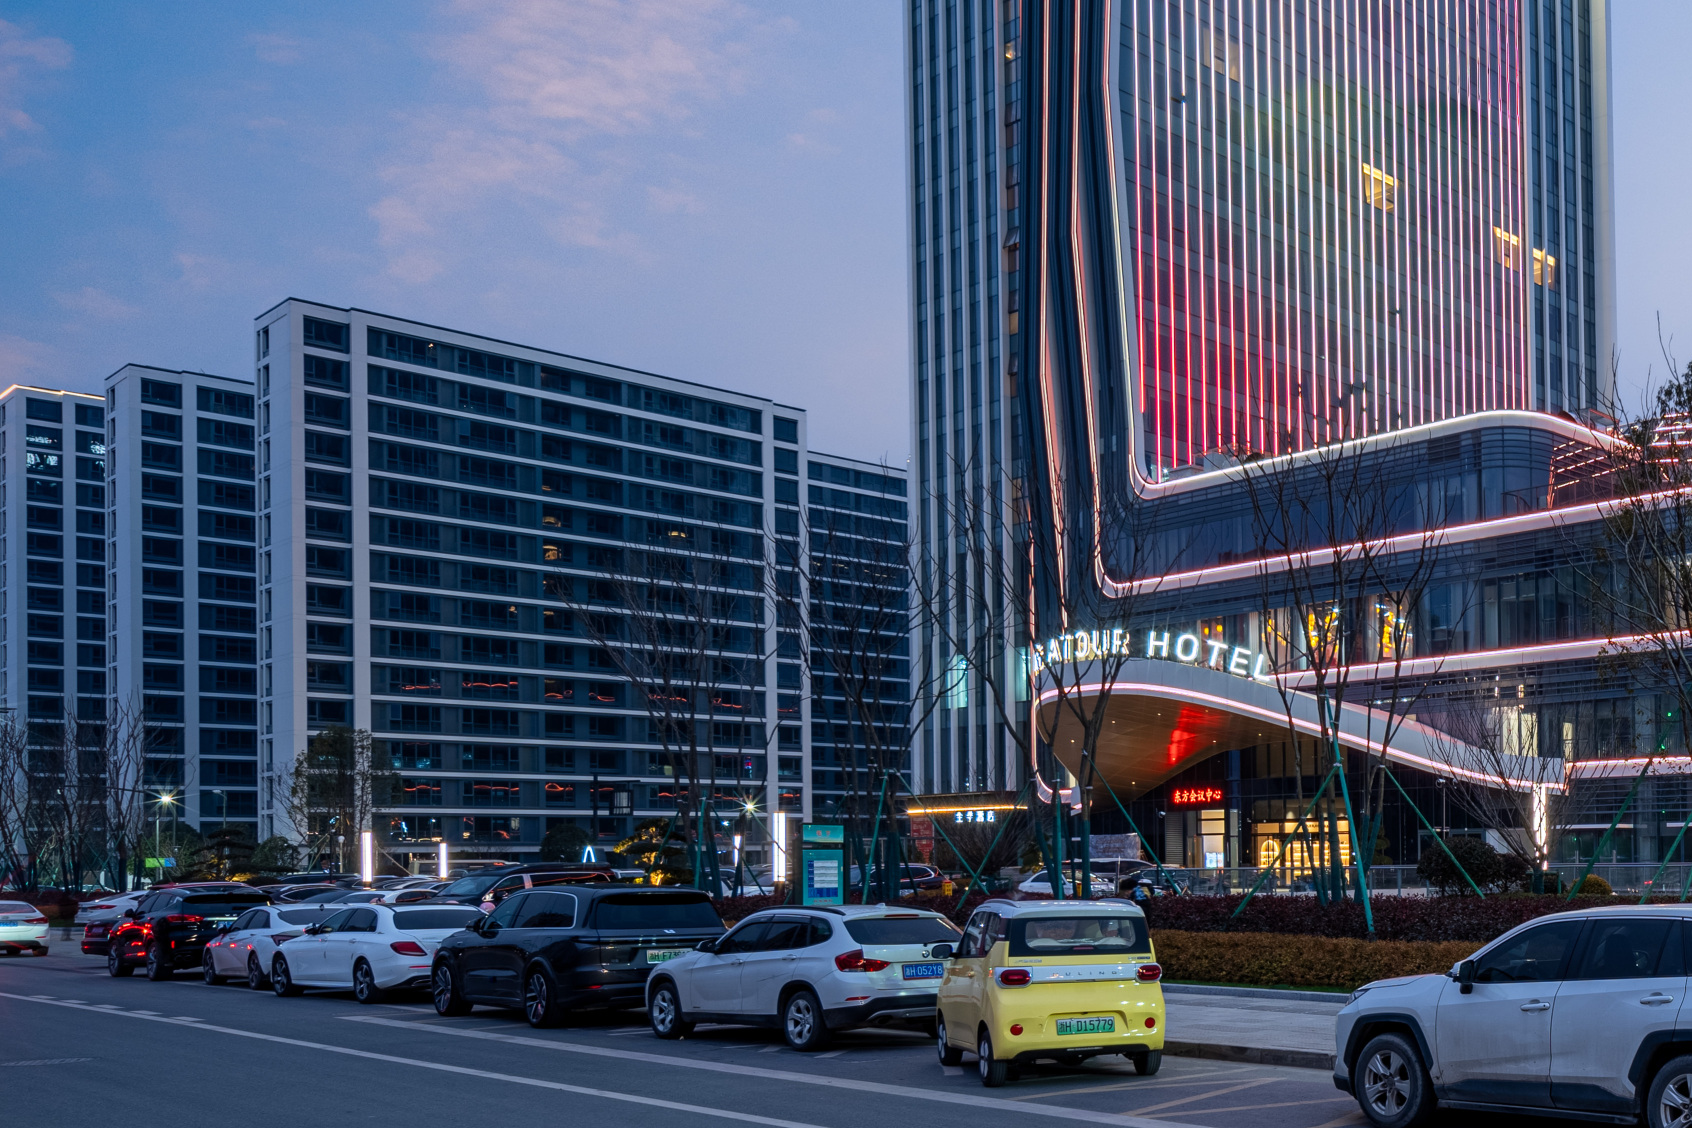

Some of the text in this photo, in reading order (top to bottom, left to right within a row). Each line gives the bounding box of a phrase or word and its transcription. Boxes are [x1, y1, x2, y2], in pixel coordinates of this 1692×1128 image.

[1147, 631, 1270, 681] HOTEL
[1174, 789, 1222, 803] 东方会议中心
